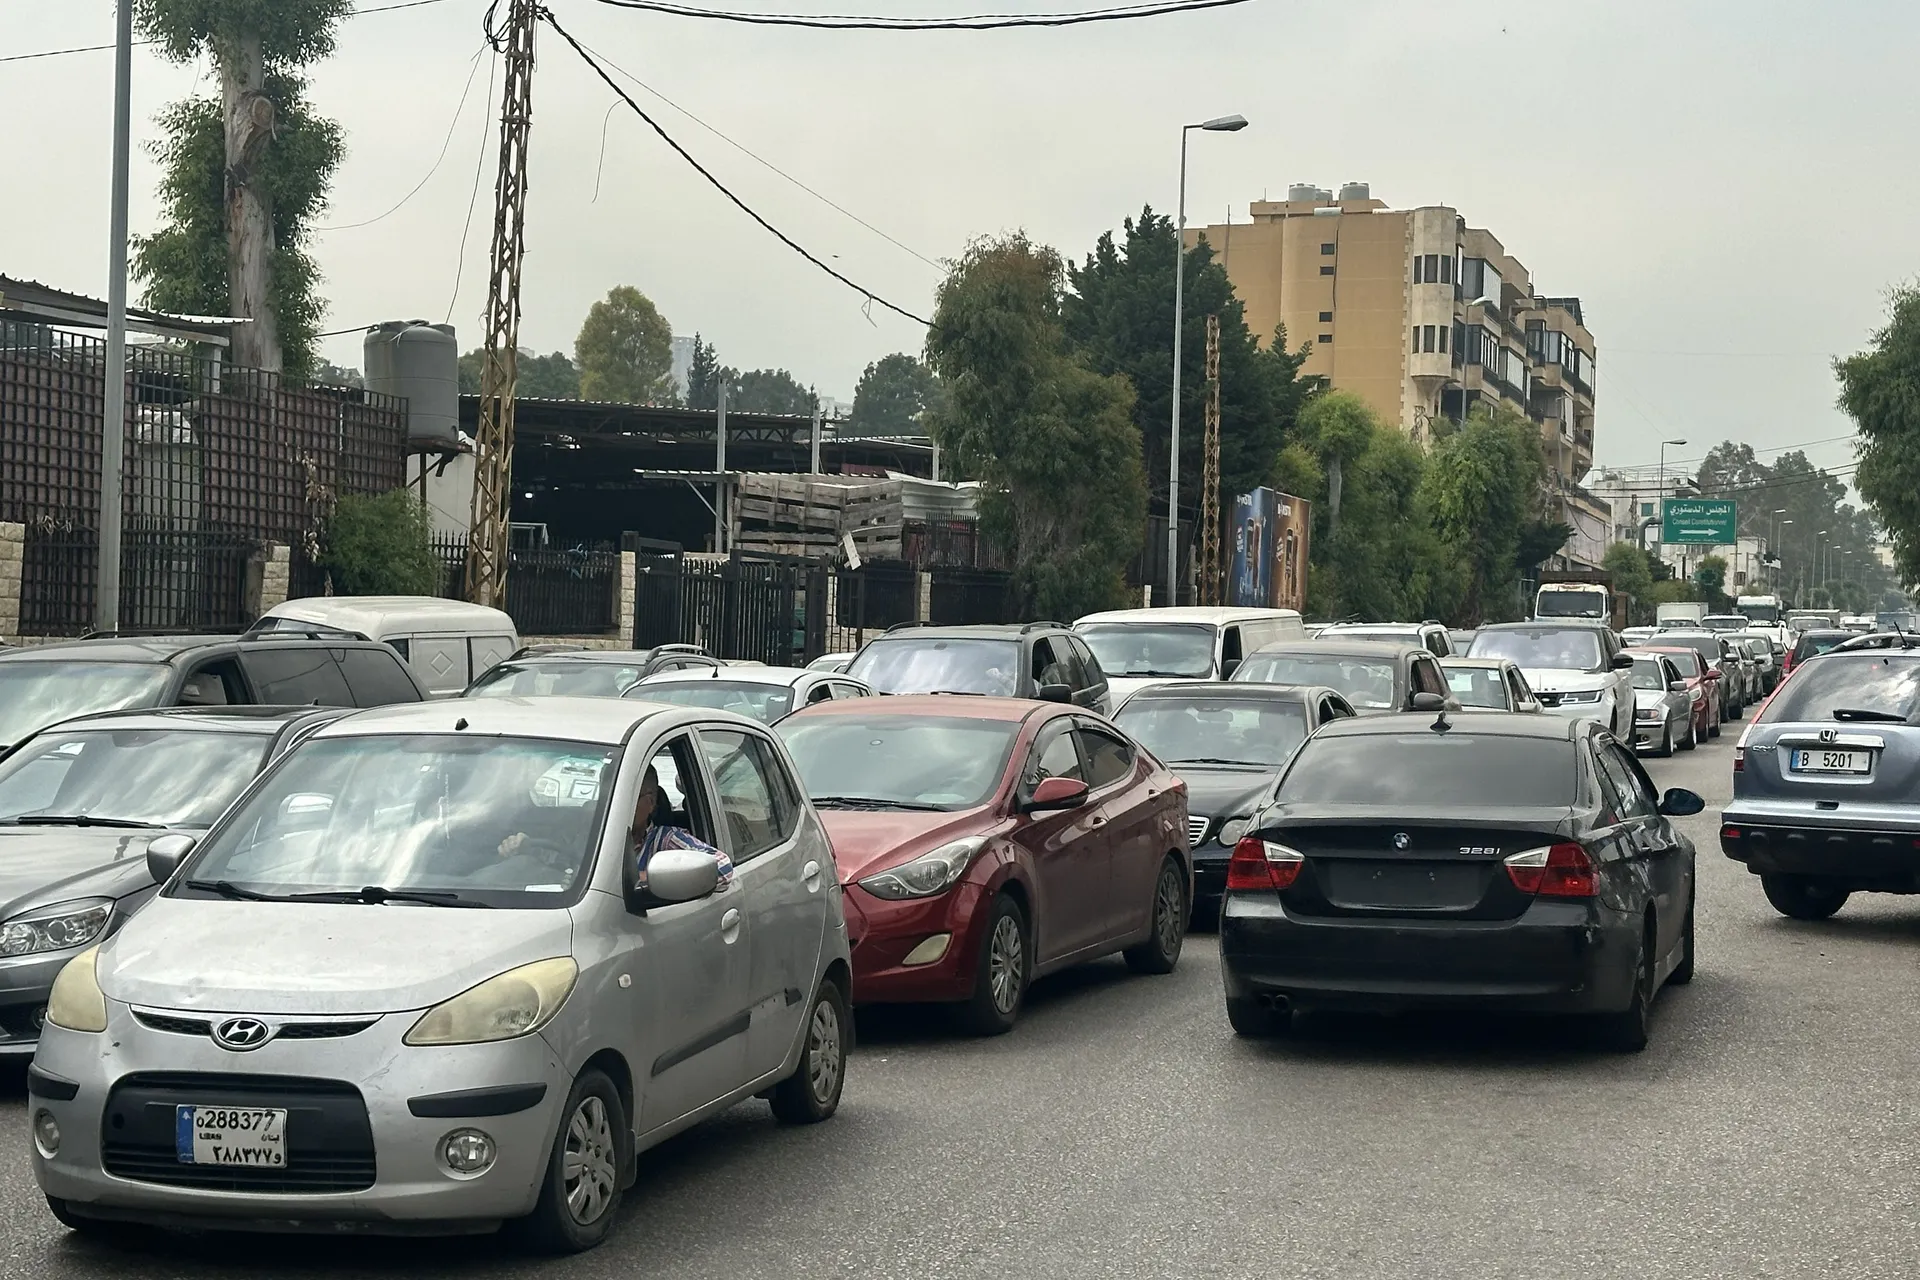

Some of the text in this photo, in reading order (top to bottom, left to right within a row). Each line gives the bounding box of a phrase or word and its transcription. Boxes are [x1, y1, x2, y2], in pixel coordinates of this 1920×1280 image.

[1669, 504, 1731, 516] المجلس الدستوري
[1801, 752, 1853, 768] B 5201
